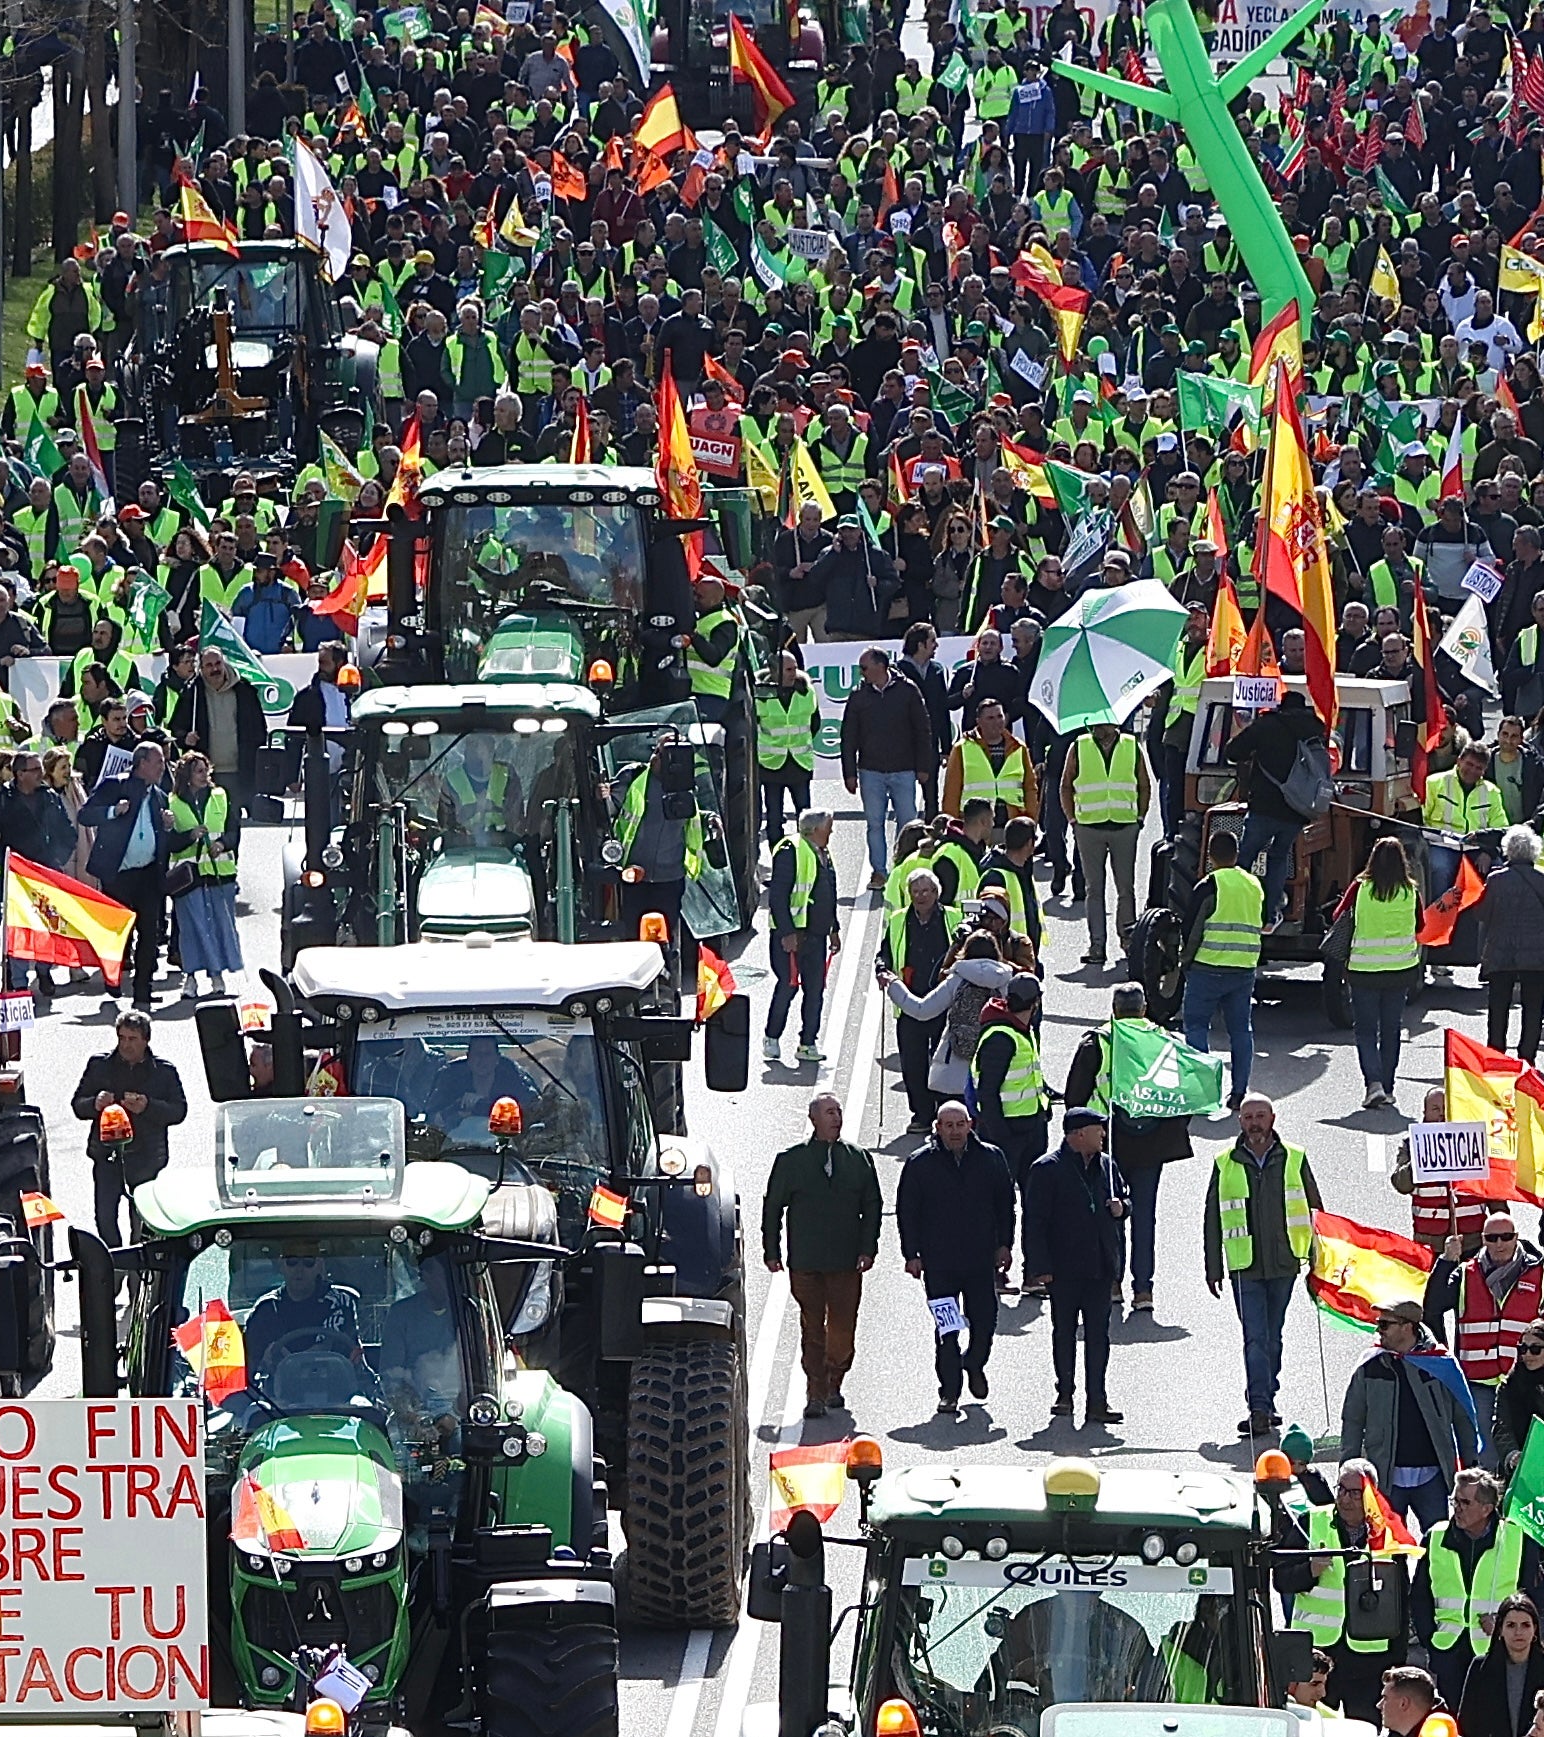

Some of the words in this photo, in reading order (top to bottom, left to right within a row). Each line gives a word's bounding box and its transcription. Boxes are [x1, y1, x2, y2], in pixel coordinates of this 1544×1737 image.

[1121, 670, 1145, 693] BKT
[1236, 680, 1277, 701] Justicia!
[1415, 1132, 1487, 1168] ¡JUSTICIA!
[87, 1404, 198, 1460] FIN
[1003, 1561, 1128, 1587] QUILES
[95, 1585, 187, 1642] TU
